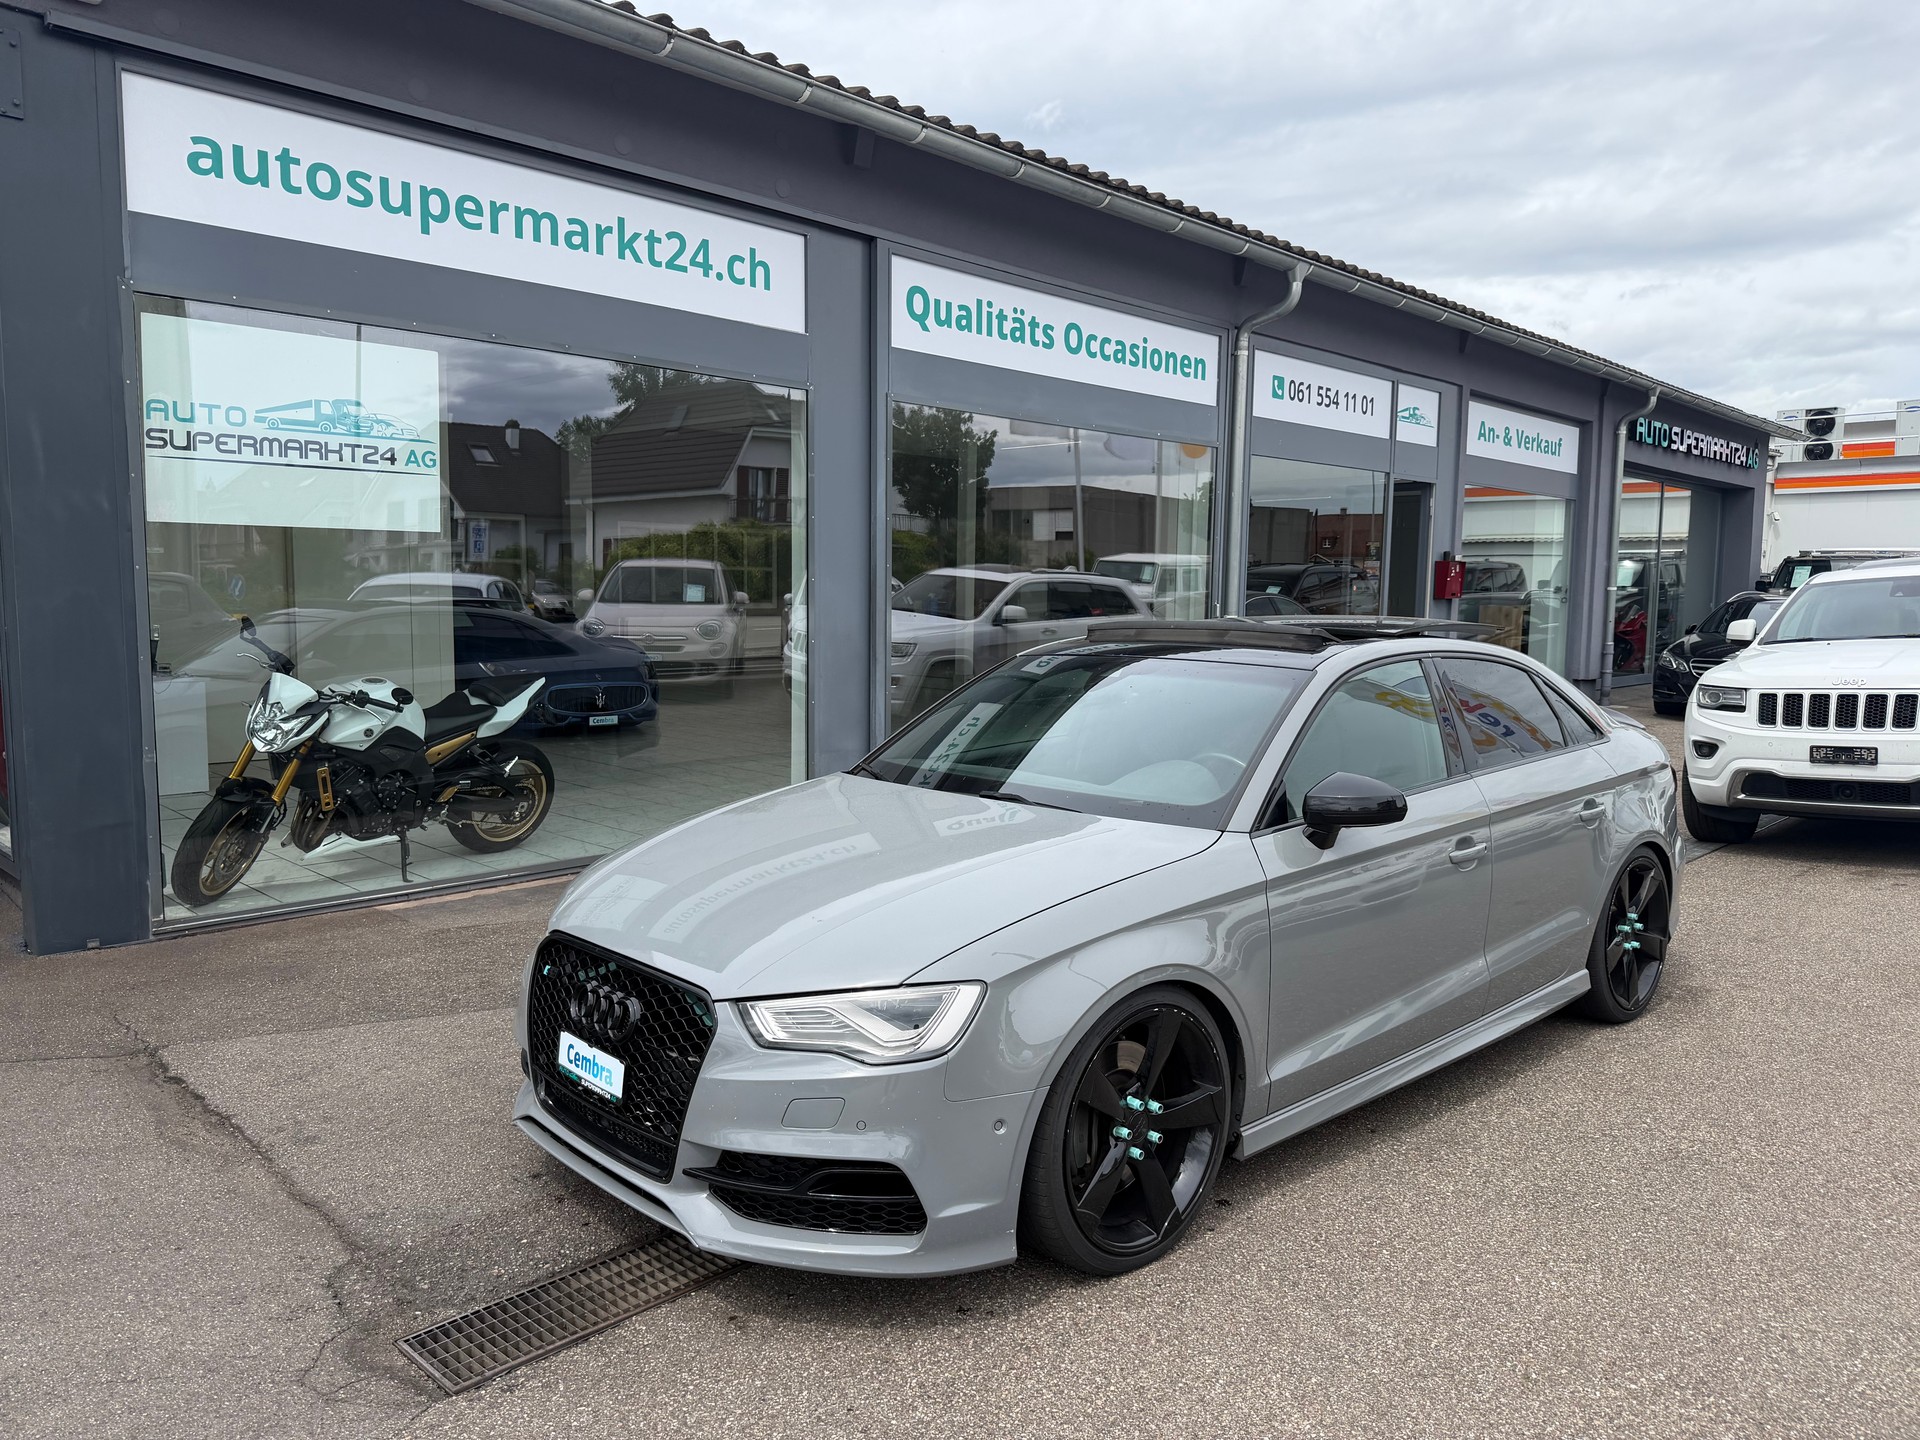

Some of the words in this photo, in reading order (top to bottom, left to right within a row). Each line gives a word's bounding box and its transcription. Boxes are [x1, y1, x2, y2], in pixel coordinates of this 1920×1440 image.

[186, 135, 771, 291] autosupermarkt24.ch
[905, 284, 1055, 350] Qualitäts
[1063, 321, 1207, 381] Occasionen
[145, 398, 247, 428] AUTO
[1288, 379, 1312, 405] 061
[1316, 385, 1340, 410] 554
[1343, 391, 1357, 413] 11
[1361, 395, 1375, 417] 01
[145, 428, 397, 466] SUPERMARKT24
[404, 449, 437, 469] AG
[1477, 420, 1500, 443] An-
[1503, 426, 1512, 447] &
[1516, 428, 1563, 457] Verkauf
[1636, 417, 1669, 448] AUTO
[1671, 426, 1747, 467] SUPERMARKT24
[1746, 447, 1759, 470] AG
[1831, 675, 1867, 688] Jeep
[567, 1043, 614, 1087] Cembra
